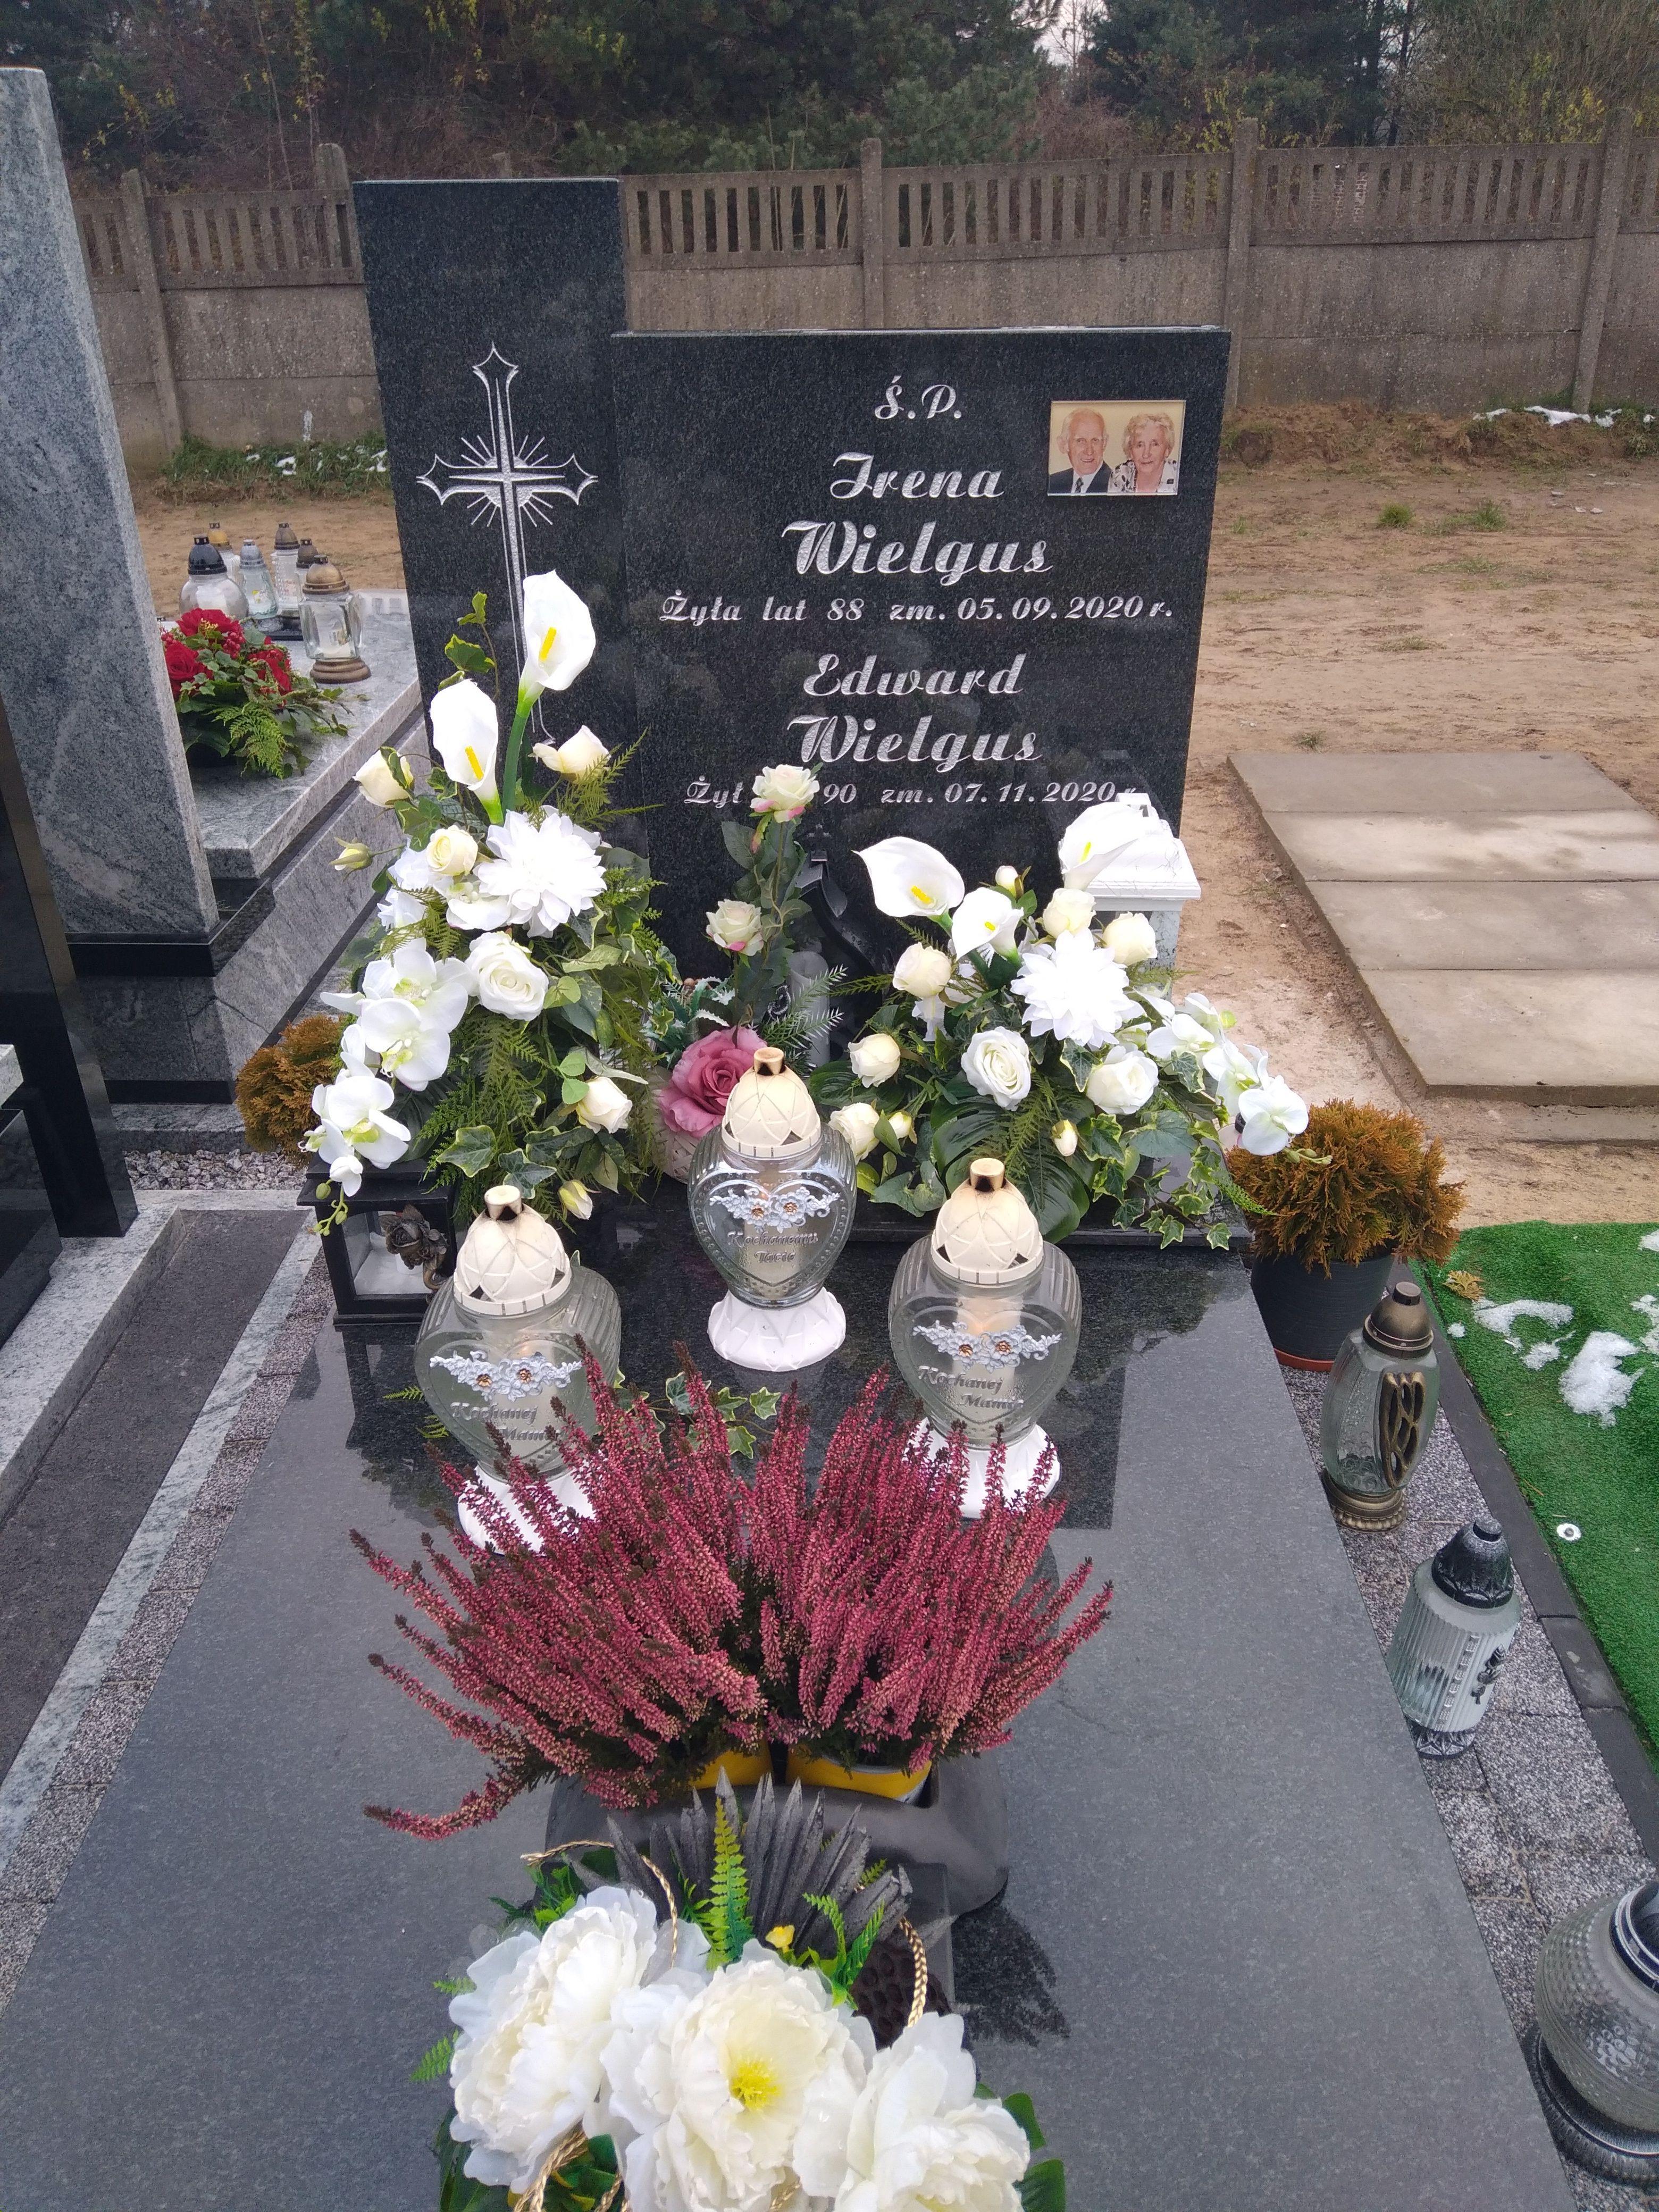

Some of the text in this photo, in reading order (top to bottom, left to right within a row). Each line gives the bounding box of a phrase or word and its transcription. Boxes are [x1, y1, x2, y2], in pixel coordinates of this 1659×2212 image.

[875, 375, 962, 419] Ś.P.
[830, 452, 1004, 499] Irena
[781, 520, 1053, 586] Wielgus
[659, 589, 742, 626] Żyła
[762, 596, 807, 621] lat
[827, 598, 865, 621] 88
[890, 604, 945, 621] zm.
[803, 653, 1027, 696] Edward
[786, 715, 1043, 773] Wielgus
[824, 783, 857, 804] 90
[881, 790, 934, 803] zm.
[918, 1365, 1003, 1395] Kochanej
[450, 1401, 539, 1425] Kochanej
